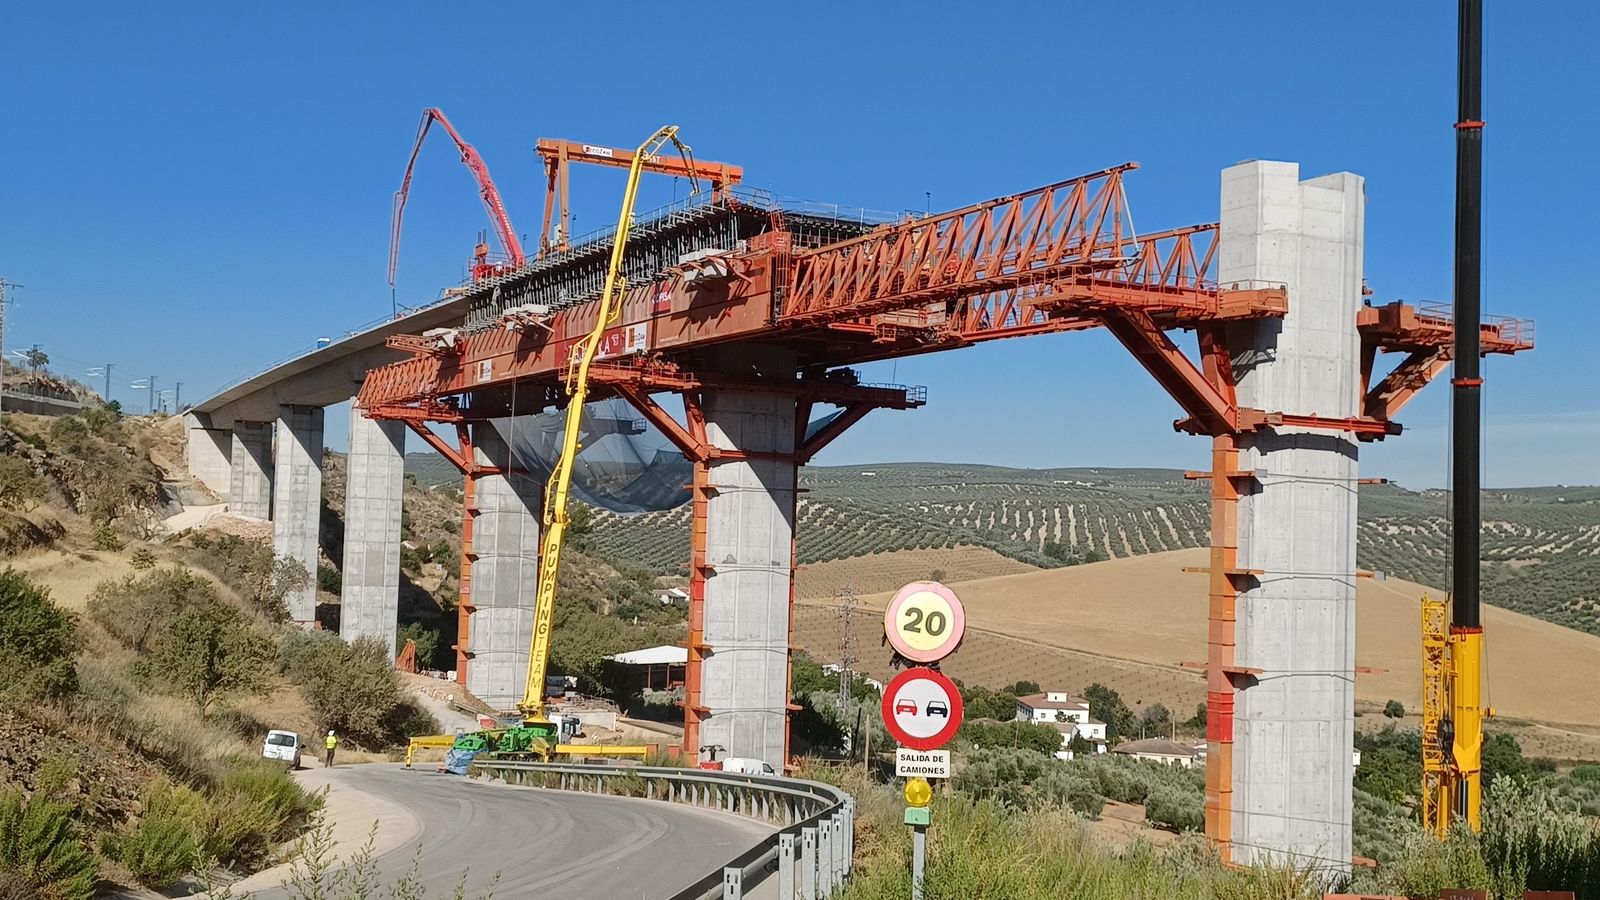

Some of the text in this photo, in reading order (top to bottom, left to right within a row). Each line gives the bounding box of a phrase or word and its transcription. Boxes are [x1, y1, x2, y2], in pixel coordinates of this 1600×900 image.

[539, 543, 557, 635] PUMPING
[903, 607, 946, 637] 20
[530, 636, 545, 688] TEAM
[900, 754, 944, 763] SALIDA DE
[900, 766, 945, 775] CAMIONES
